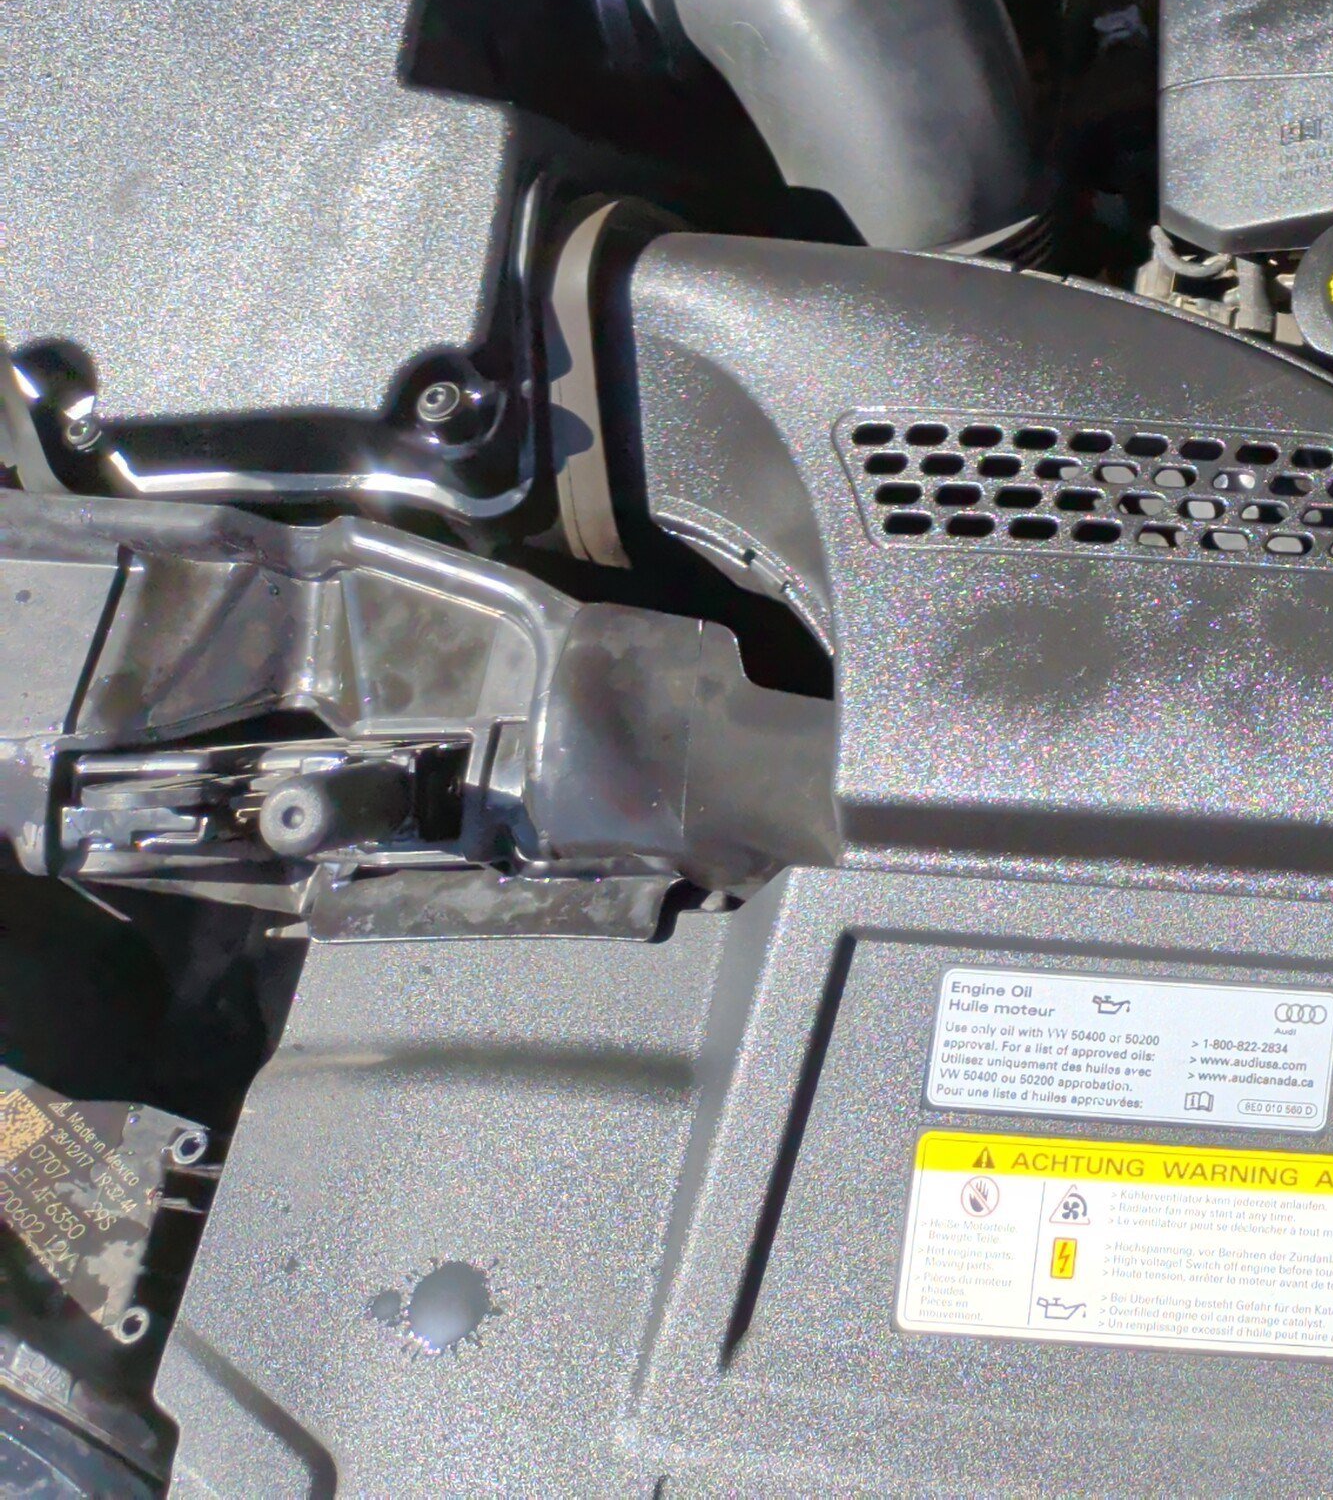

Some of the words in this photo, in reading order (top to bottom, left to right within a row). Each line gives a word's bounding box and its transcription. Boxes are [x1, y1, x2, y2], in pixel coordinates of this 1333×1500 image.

[951, 982, 1005, 997] Engine
[1011, 986, 1032, 998] Oil
[949, 999, 989, 1013] Huile
[994, 1004, 1055, 1018] moteur
[946, 1022, 967, 1033] Use
[971, 1024, 996, 1038] only
[1000, 1025, 1014, 1036] oil
[1019, 1027, 1043, 1038] with
[1048, 1028, 1067, 1040] VW
[1071, 1030, 1105, 1042] 50400
[1109, 1035, 1121, 1043] or
[1125, 1033, 1159, 1046] 50200
[1274, 1028, 1296, 1036] Audi
[943, 1040, 998, 1052] approval.
[1002, 1042, 1020, 1053] For
[1035, 1044, 1052, 1055] list
[1056, 1046, 1067, 1056] of
[1072, 1049, 1127, 1061] approved
[1131, 1051, 1155, 1062] oils:
[1203, 1039, 1288, 1054] 1-800-822-2834
[941, 1053, 983, 1066] Utilisez
[987, 1058, 1058, 1071] uniquement
[1062, 1062, 1082, 1072] des
[1086, 1063, 1119, 1075] huiles
[1124, 1068, 1152, 1077] avec
[1201, 1057, 1307, 1071] www.audiusa.com
[940, 1069, 959, 1080] VW
[963, 1070, 998, 1083] 50400
[1001, 1076, 1016, 1084] ou
[1020, 1075, 1054, 1087] 50200
[1058, 1079, 1133, 1092] approbation.
[1198, 1072, 1313, 1088] www.audicanada.ca
[937, 1084, 964, 1096] Pour
[968, 1089, 988, 1098] une
[993, 1088, 1016, 1100] liste
[1305, 1106, 1313, 1115] D
[29, 1144, 70, 1178] 0707
[102, 1148, 139, 1186] Mexico
[1011, 1153, 1145, 1179] ACHTUNG
[1164, 1161, 1299, 1189] WARNING
[1119, 1202, 1161, 1214] Radiator
[1166, 1205, 1181, 1215] fan
[1184, 1209, 1205, 1219] may
[1210, 1208, 1232, 1219] start
[1236, 1210, 1245, 1219] at
[1249, 1213, 1267, 1223] any
[1270, 1212, 1296, 1222] time.
[1117, 1216, 1130, 1225] Le
[1132, 1218, 1187, 1229] ventilateur
[1190, 1221, 1213, 1232] peut
[1217, 1224, 1228, 1232] se
[1299, 1227, 1320, 1237] tout
[1113, 1255, 1137, 1268] High
[1186, 1260, 1220, 1271] Switch
[1224, 1262, 1237, 1272] off
[1241, 1264, 1276, 1276] engine
[1279, 1265, 1312, 1277] before
[1199, 1249, 1215, 1257] vor
[1269, 1251, 1286, 1261] der
[1112, 1268, 1142, 1279] Haute
[1226, 1275, 1235, 1284] le
[1239, 1277, 1276, 1287] moteur
[1279, 1280, 1308, 1289] avant
[1311, 1280, 1324, 1290] de
[1110, 1292, 1126, 1303] Bei
[1195, 1297, 1232, 1309] besteht
[1236, 1299, 1270, 1311] Gefahr
[1274, 1302, 1289, 1312] für
[1292, 1303, 1311, 1314] den
[1109, 1305, 1159, 1318] Overfilled
[1162, 1310, 1197, 1322] engine
[1201, 1311, 1213, 1322] oil
[1216, 1315, 1234, 1323] can
[1238, 1314, 1279, 1328] damage
[1283, 1317, 1325, 1331] catalyst.
[1108, 1319, 1122, 1329] Un
[1125, 1322, 1188, 1335] remplissage
[1192, 1326, 1233, 1336] excessif
[1275, 1331, 1297, 1342] peut
[1301, 1332, 1328, 1343] nuire
